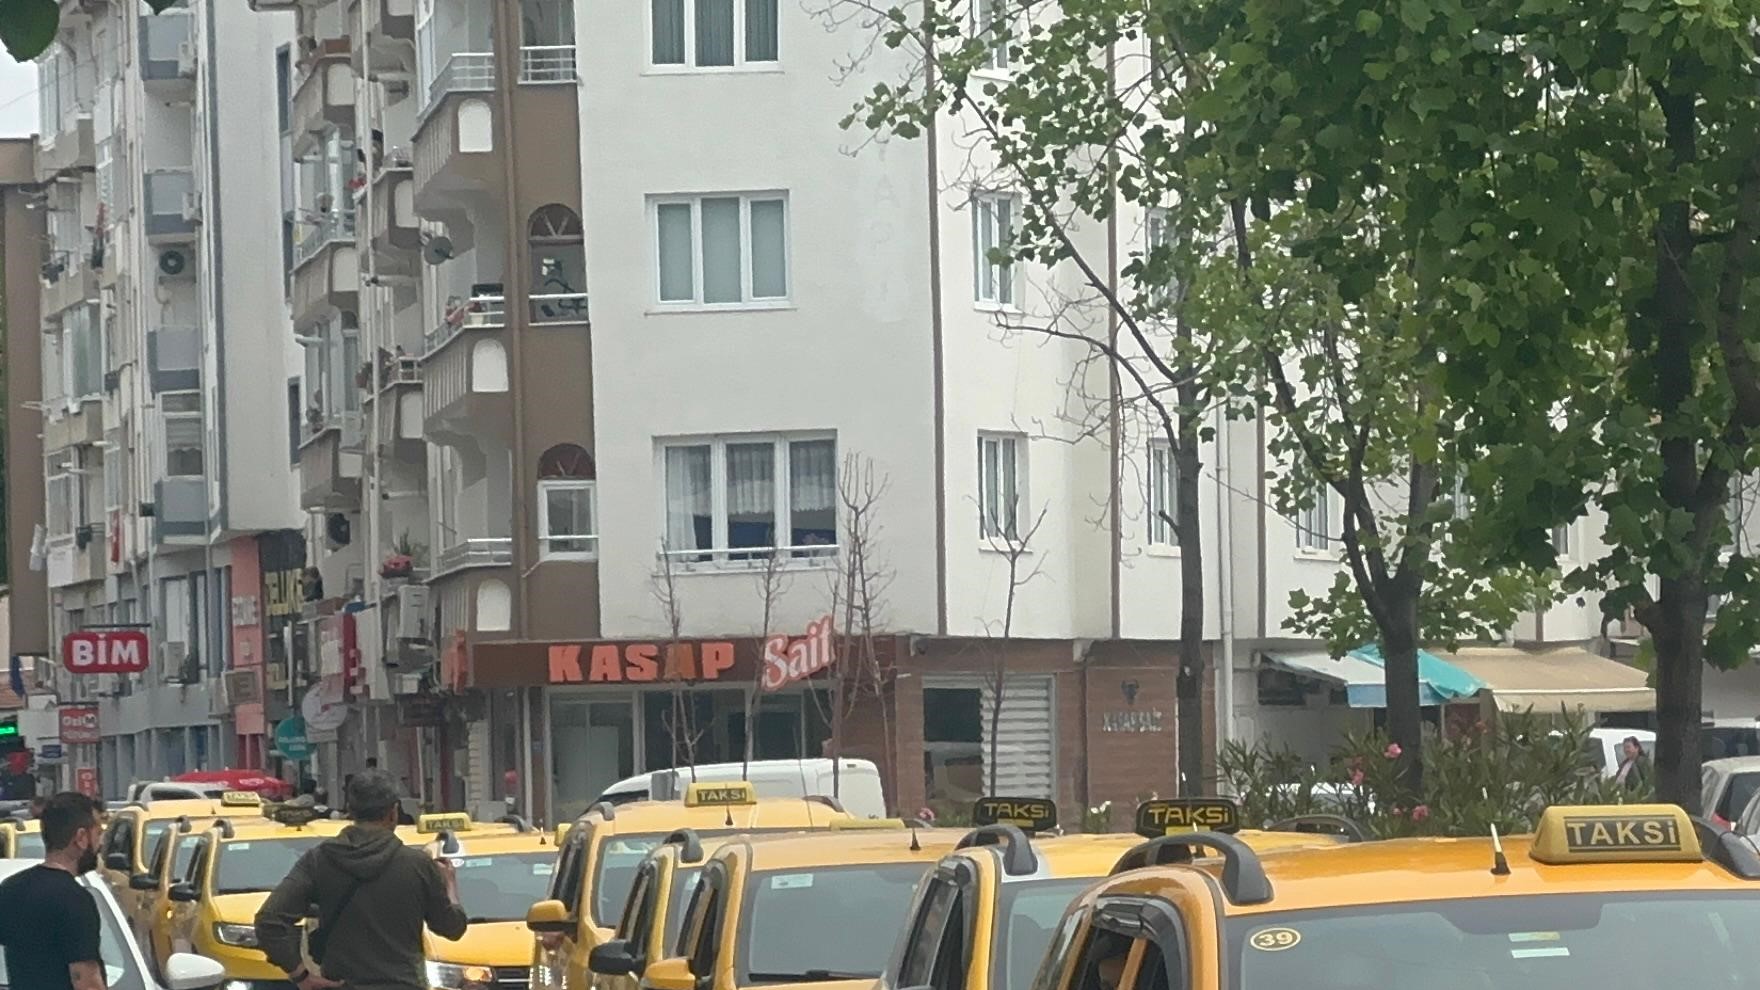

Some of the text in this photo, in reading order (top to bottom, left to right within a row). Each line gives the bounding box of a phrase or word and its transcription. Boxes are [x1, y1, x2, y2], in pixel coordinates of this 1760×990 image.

[548, 642, 734, 683] KASAP
[763, 614, 837, 691] Sait
[1257, 931, 1293, 947] 39
